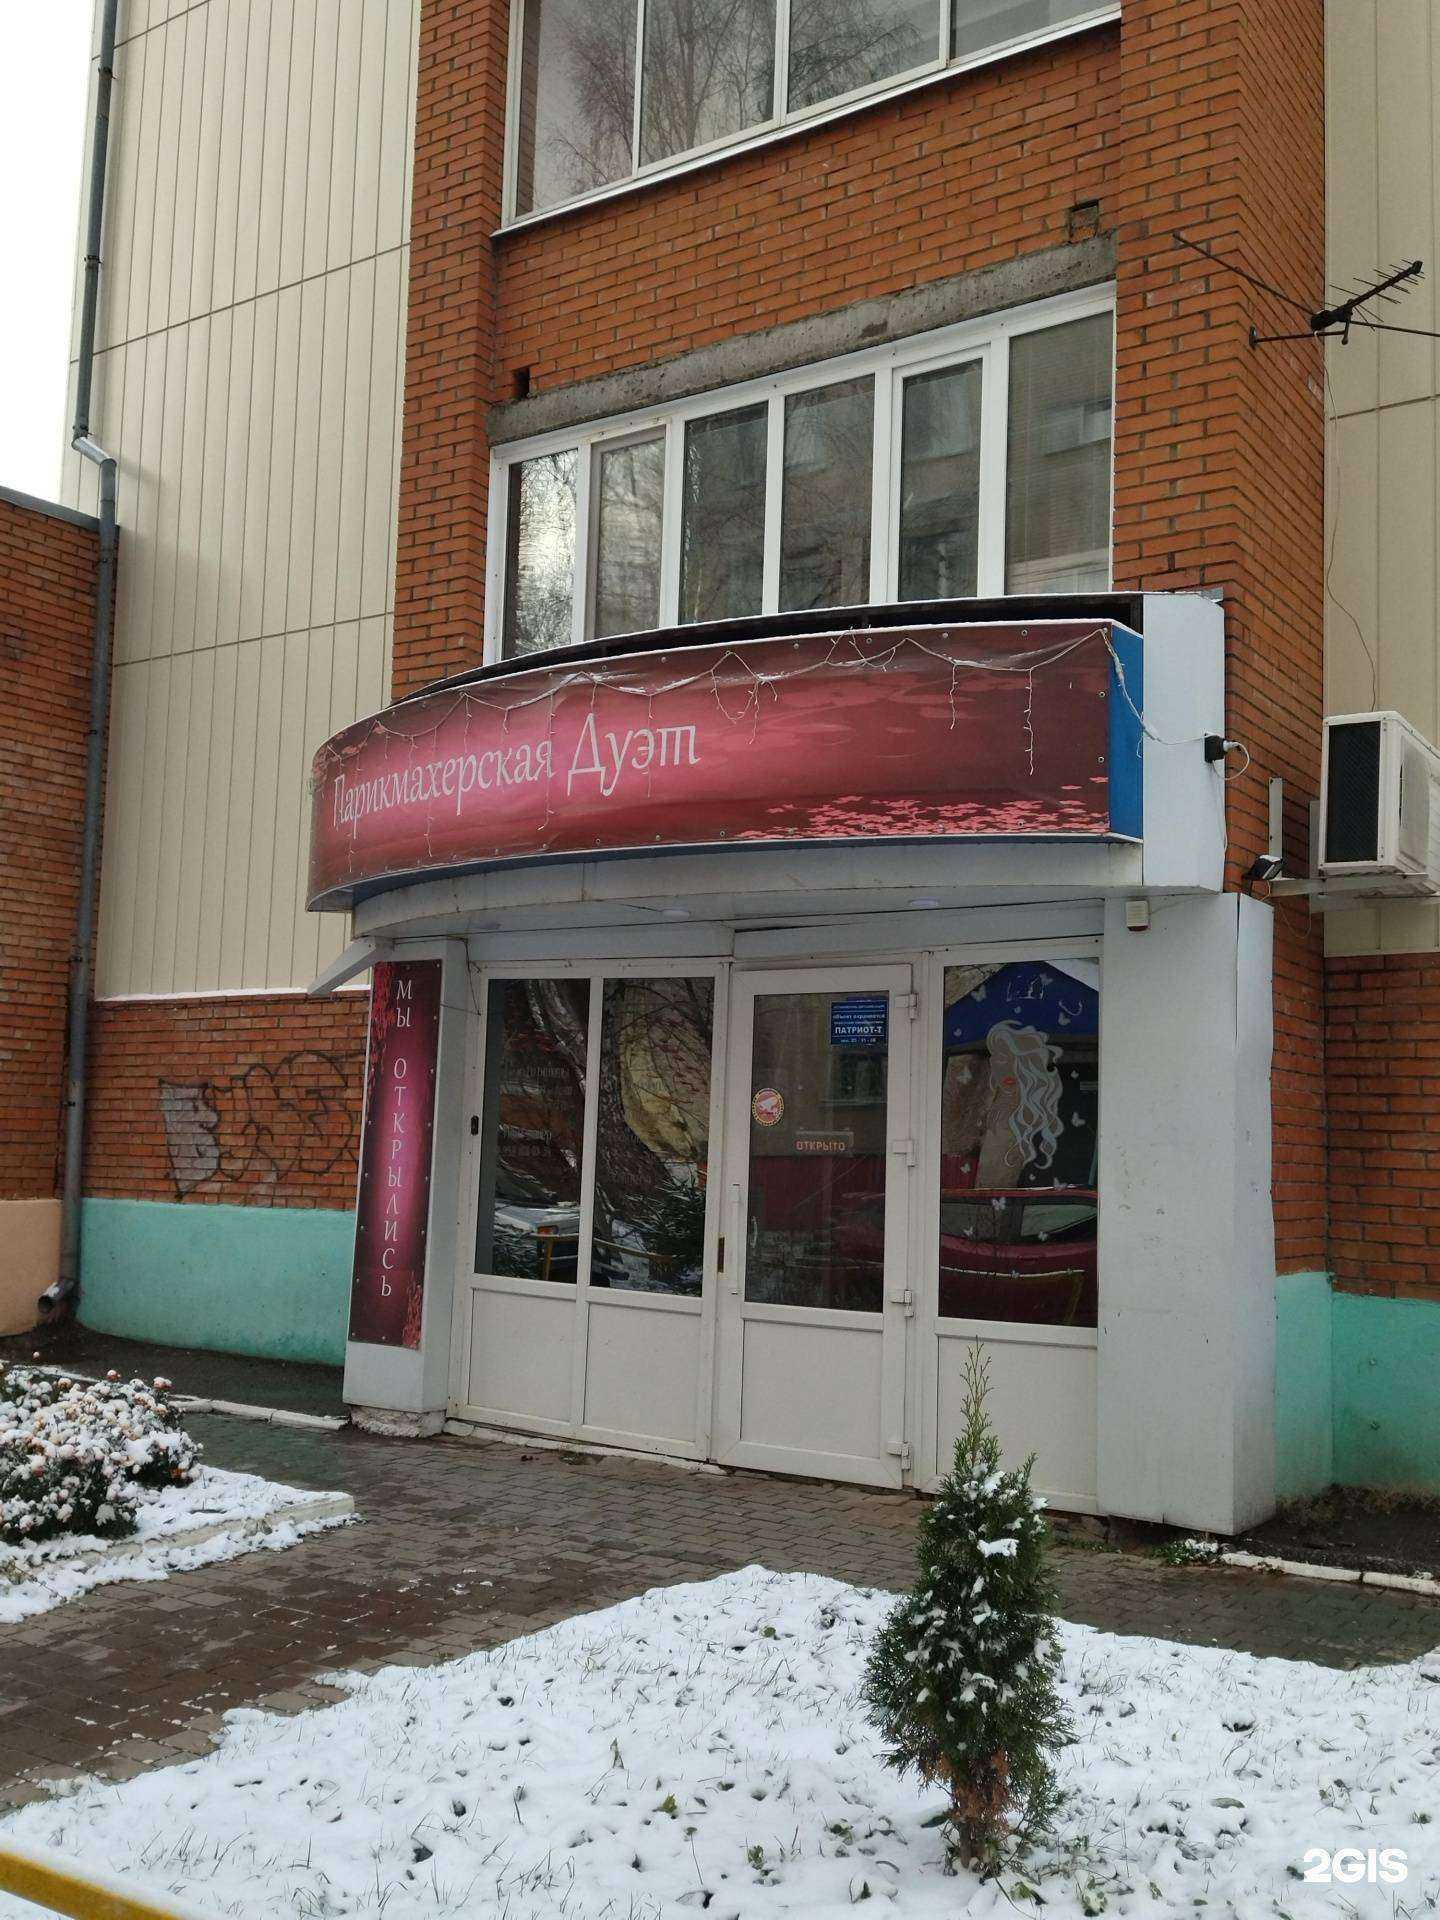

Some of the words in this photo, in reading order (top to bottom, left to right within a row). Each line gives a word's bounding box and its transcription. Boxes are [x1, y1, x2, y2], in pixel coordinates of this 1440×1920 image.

[333, 740, 555, 840] Парикмахерская
[567, 712, 702, 796] Дуэт
[834, 1026, 883, 1035] ПАТРИОТ-Т
[381, 1057, 407, 1297] ОТКРЫЛИСЬ
[796, 1140, 846, 1152] ОТКРЫТО
